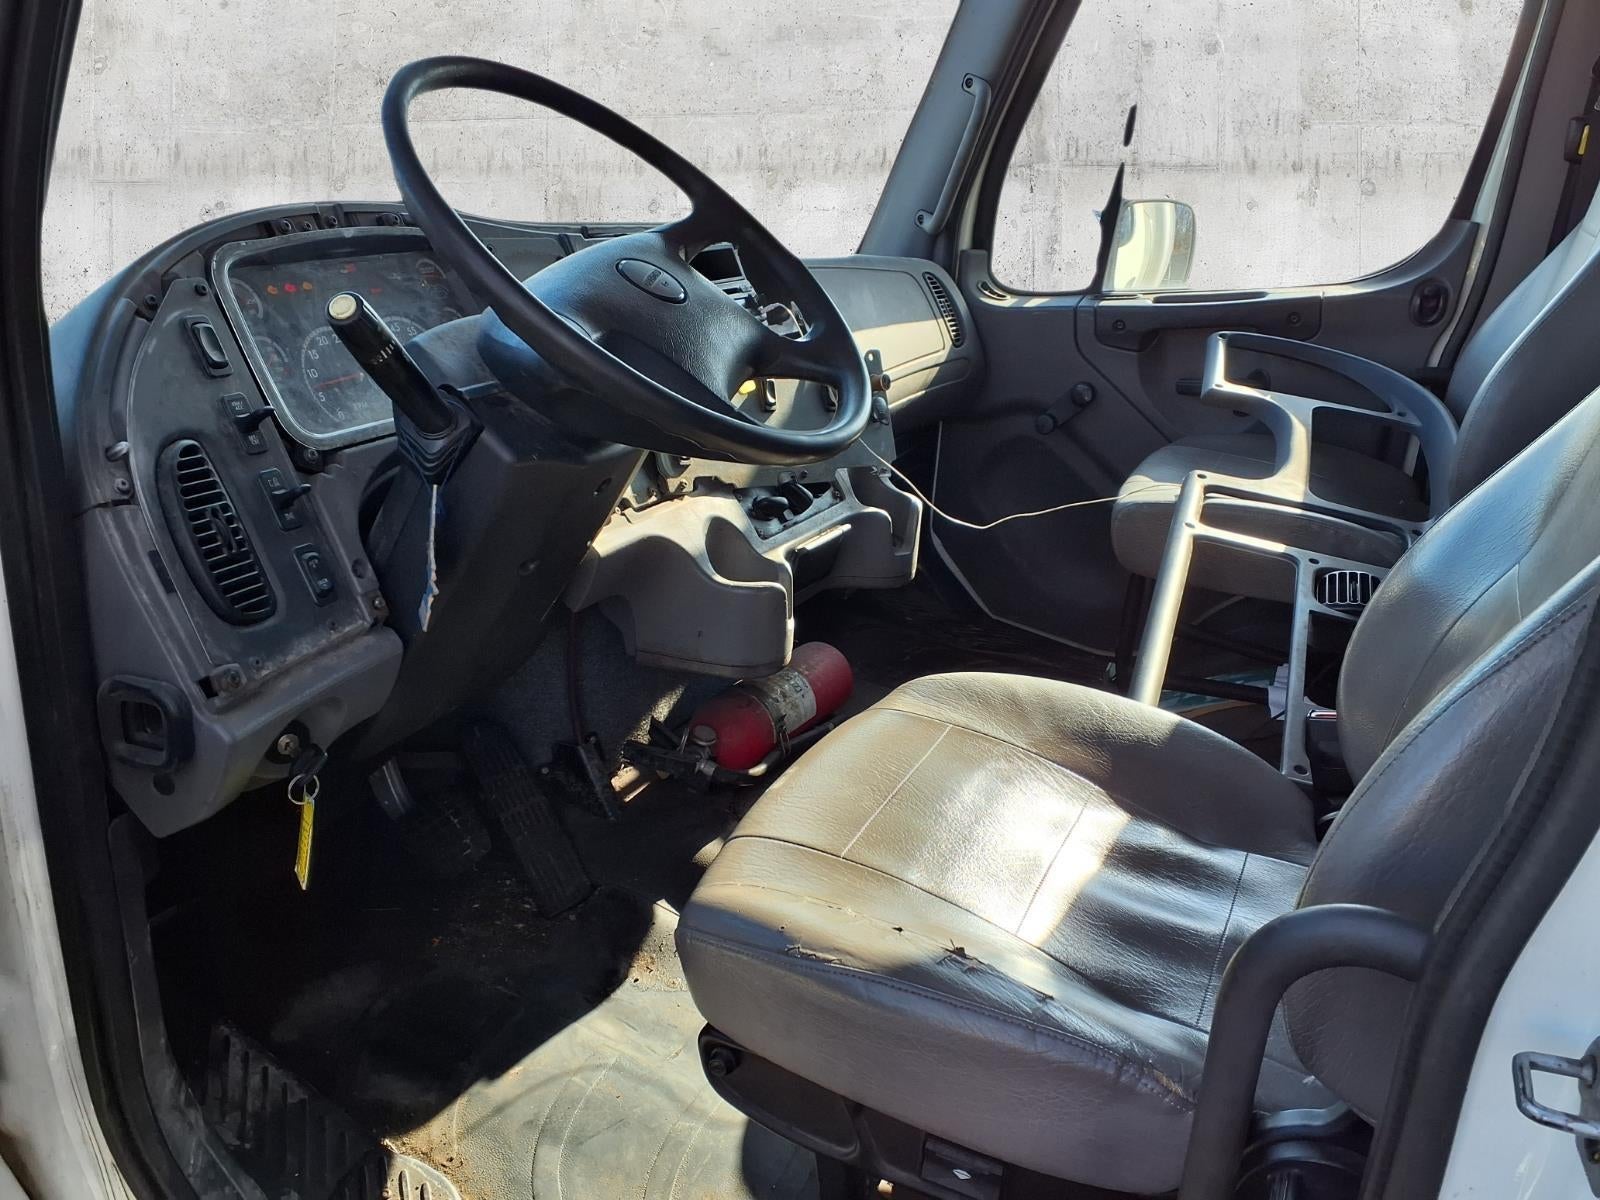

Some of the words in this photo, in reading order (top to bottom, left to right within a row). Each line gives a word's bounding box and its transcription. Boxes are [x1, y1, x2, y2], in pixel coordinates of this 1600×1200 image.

[406, 326, 417, 337] 55
[316, 335, 329, 346] 20
[307, 349, 320, 360] 15
[306, 368, 319, 379] 10
[318, 391, 326, 402] 5
